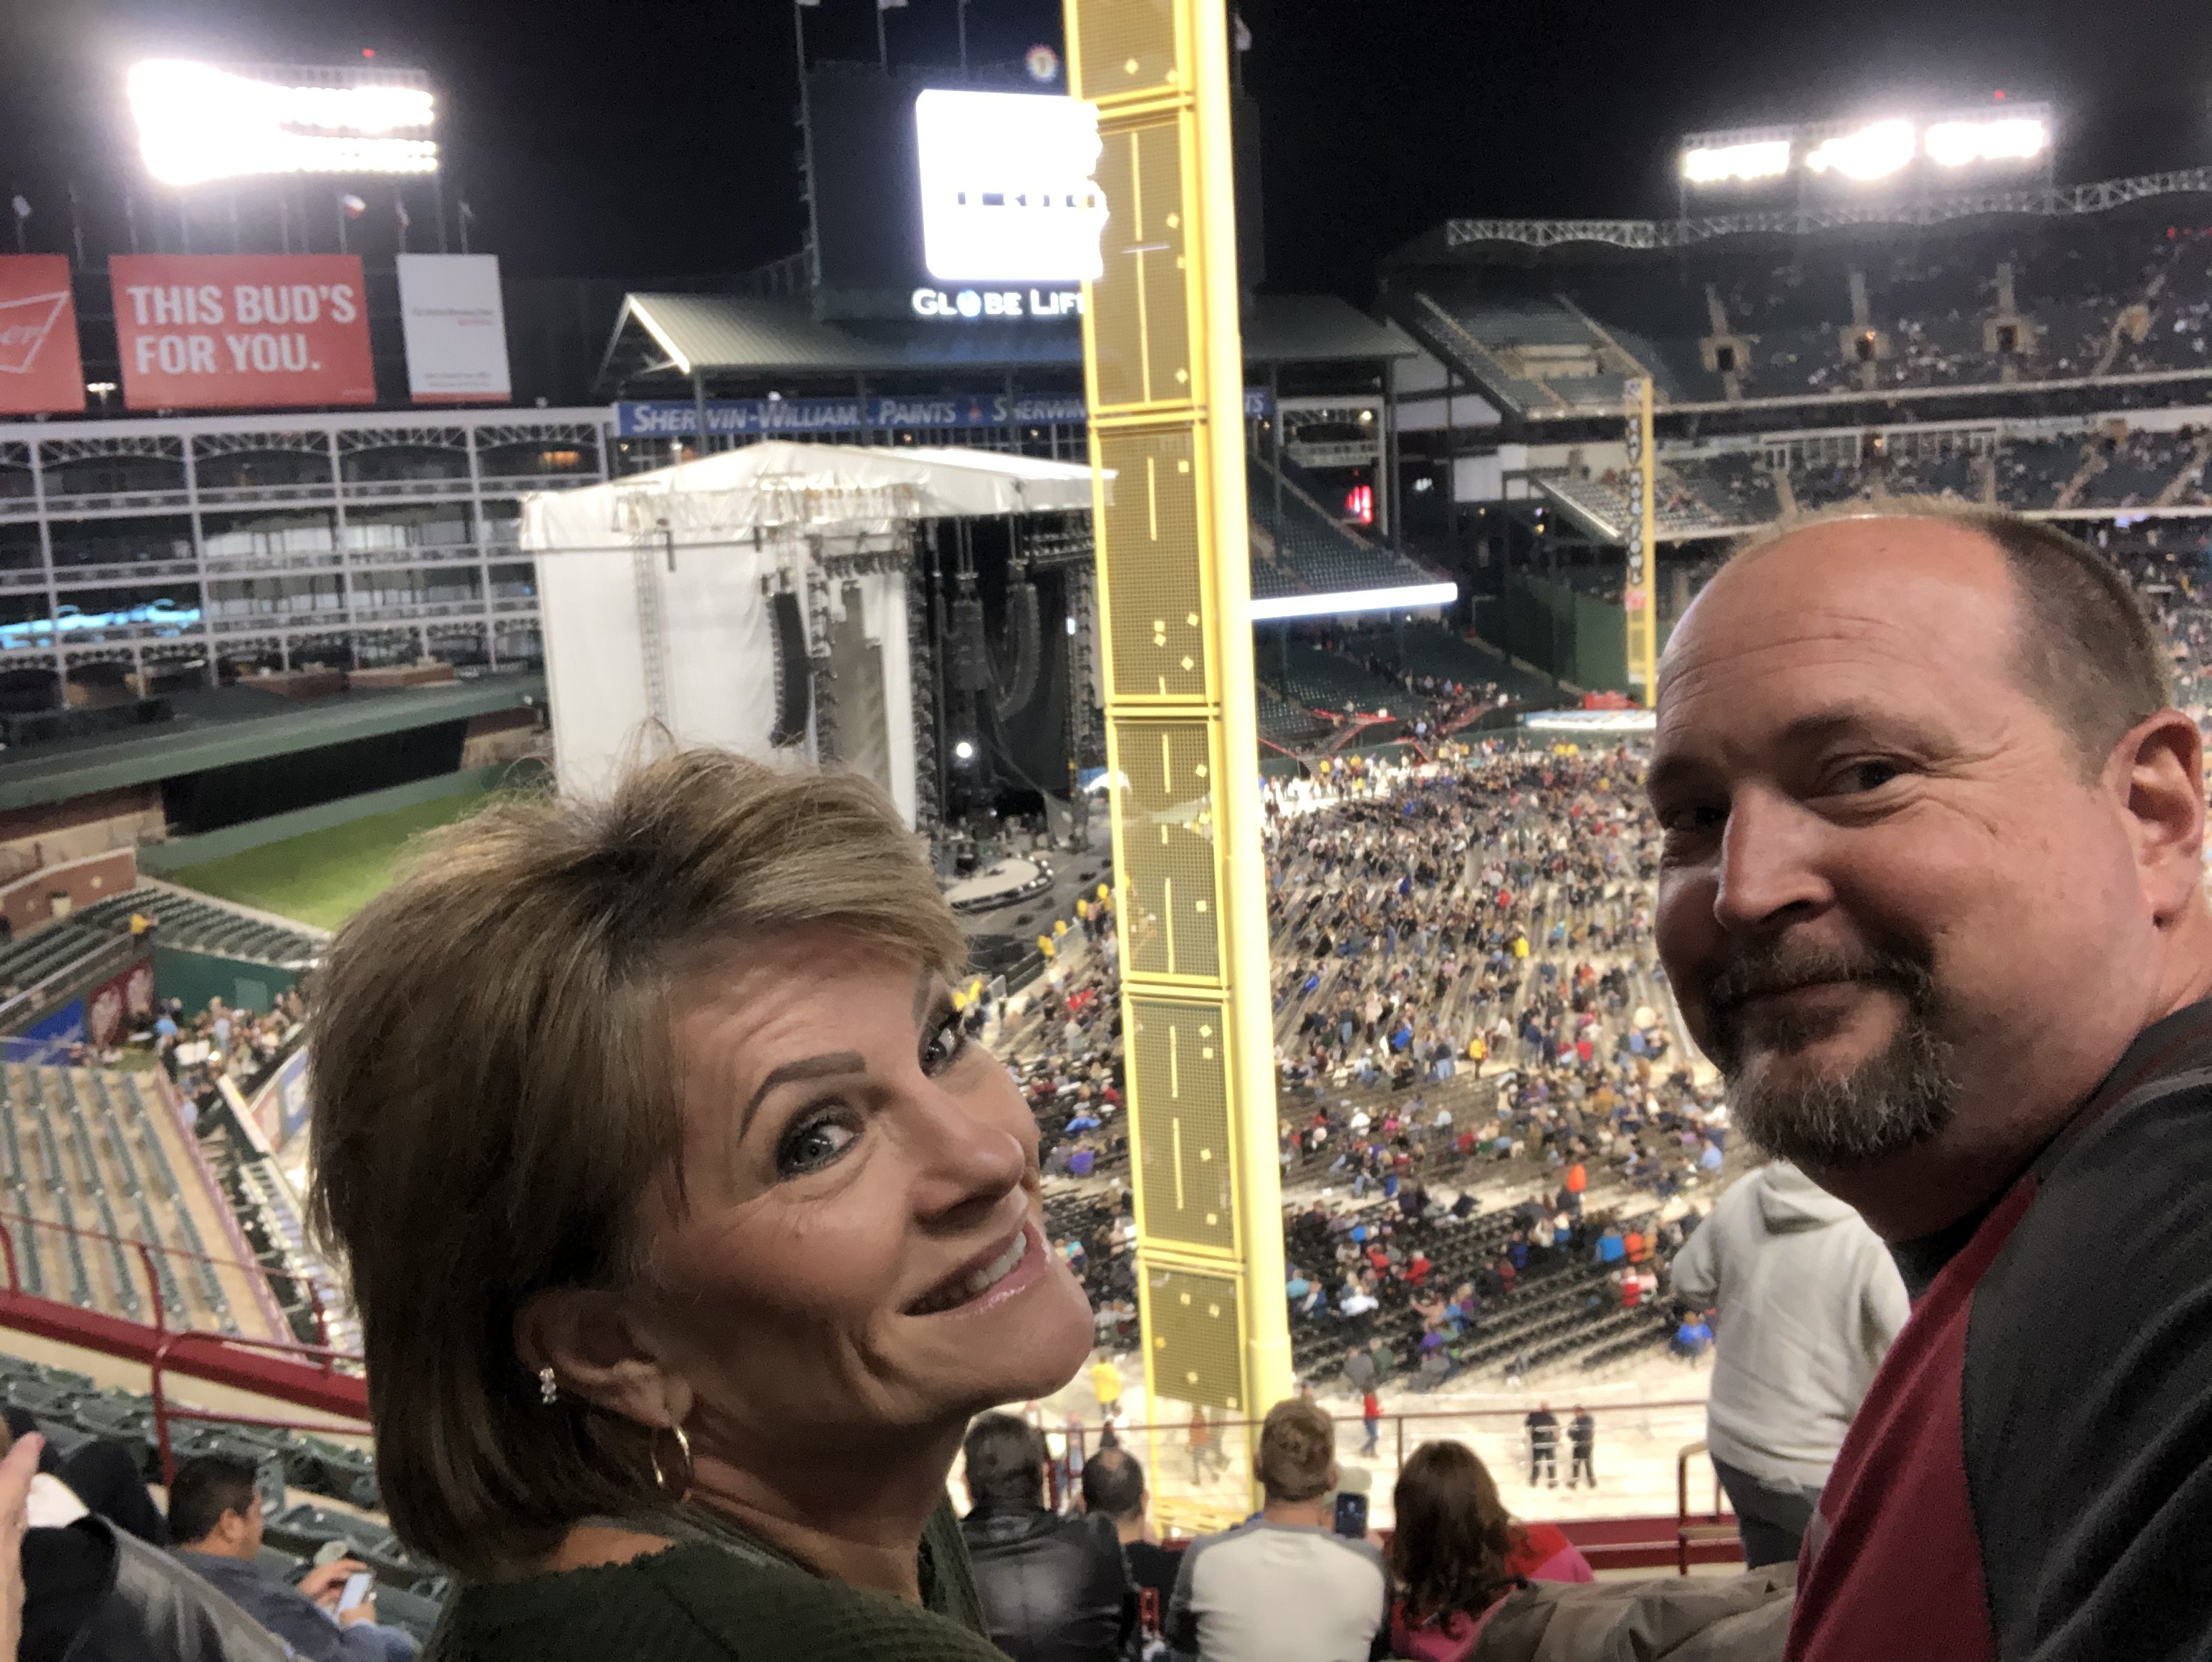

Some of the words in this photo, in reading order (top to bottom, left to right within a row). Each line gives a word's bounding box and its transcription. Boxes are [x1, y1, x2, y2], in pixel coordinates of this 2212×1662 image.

[126, 285, 224, 325] THIS
[234, 284, 357, 324] BUD'S
[913, 288, 1023, 317] GLOBE
[135, 334, 216, 374] FOR
[223, 332, 322, 373] YOU.
[878, 398, 957, 424] PAINTS
